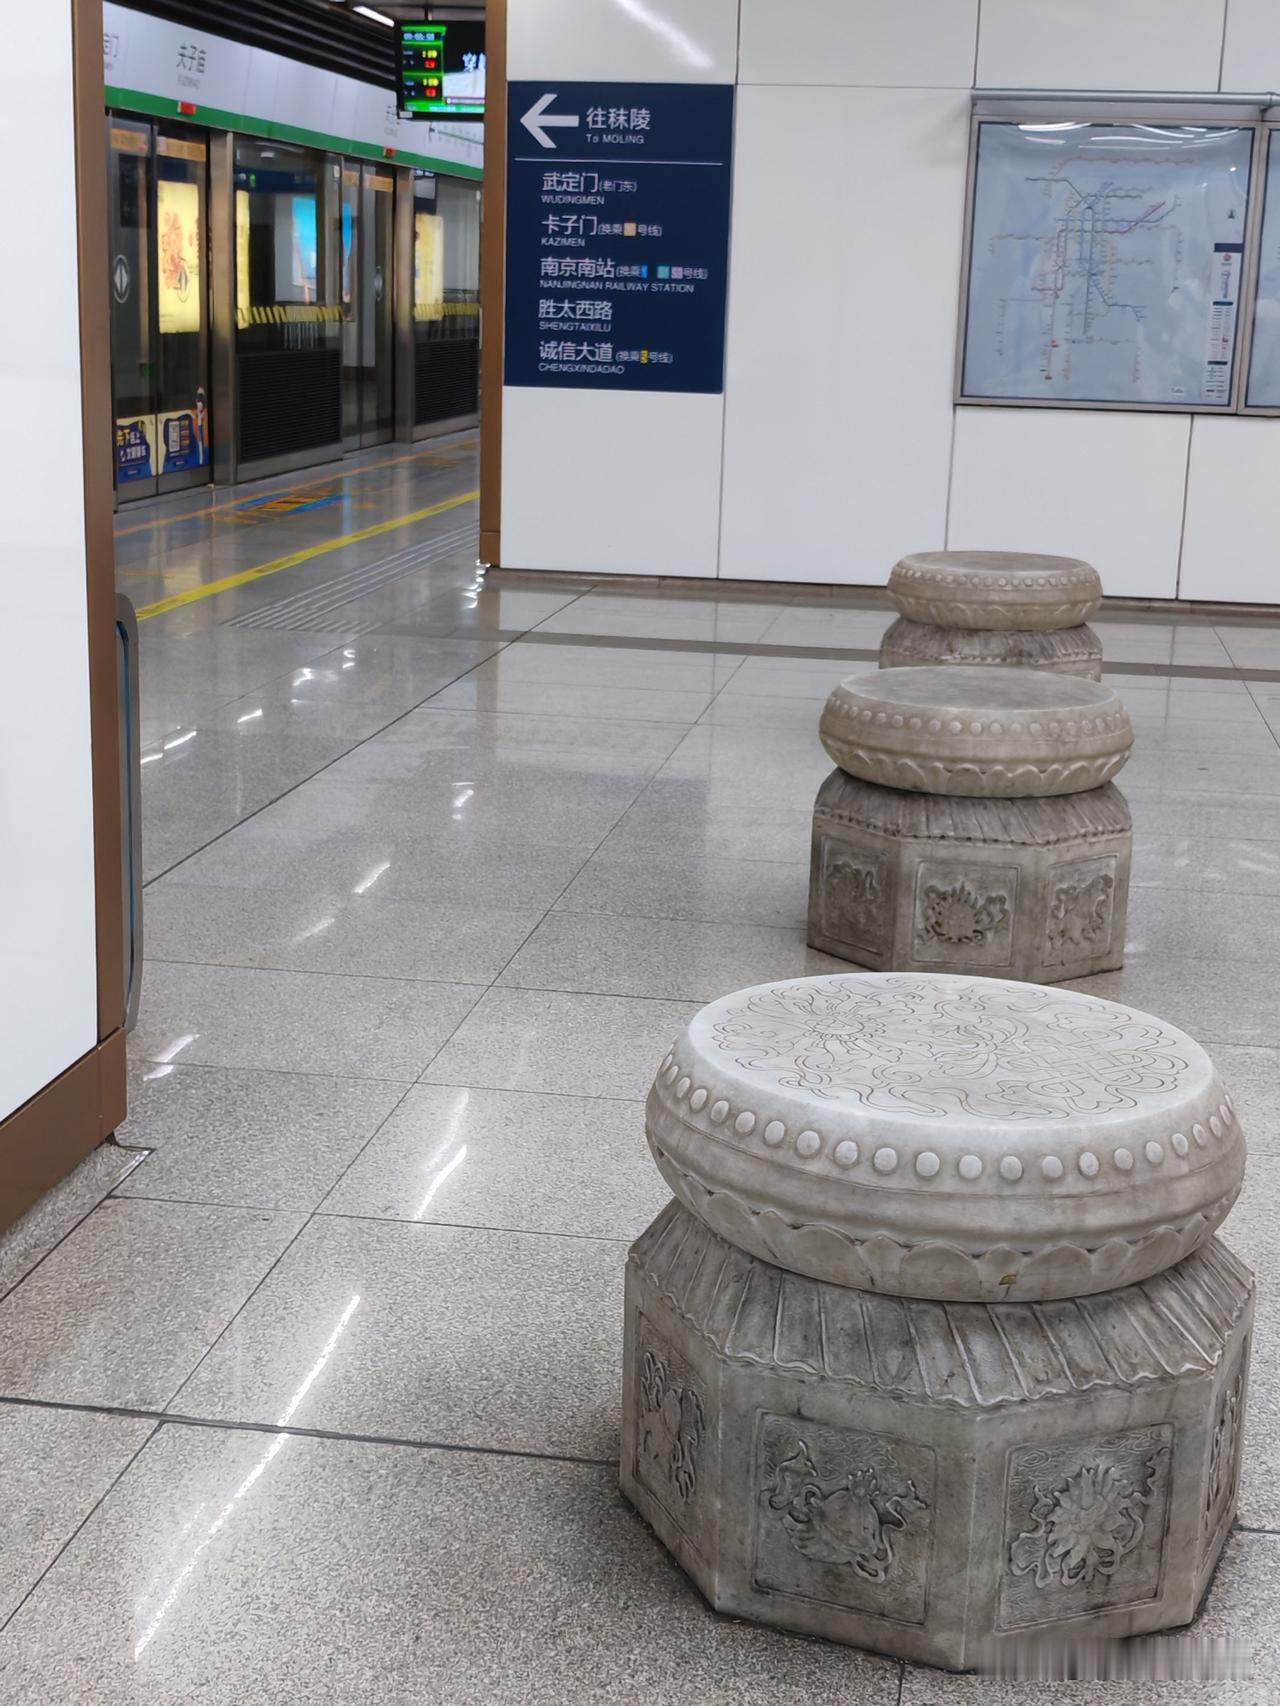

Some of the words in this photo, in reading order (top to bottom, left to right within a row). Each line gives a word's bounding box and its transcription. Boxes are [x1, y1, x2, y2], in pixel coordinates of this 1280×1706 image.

[586, 106, 651, 131] 往秣陵
[586, 134, 599, 143] To
[602, 134, 644, 144] MOLING
[541, 195, 605, 205] WUDINGMEN
[541, 238, 586, 247] KAZIMEN
[539, 280, 603, 290] NANJINGNAN
[605, 282, 650, 292] RAILWAY
[651, 283, 694, 293] STATION
[538, 299, 613, 320] 胜太西路
[538, 322, 612, 332] SHENGTAIXILU
[538, 363, 625, 374] CHENGXINDADAO
